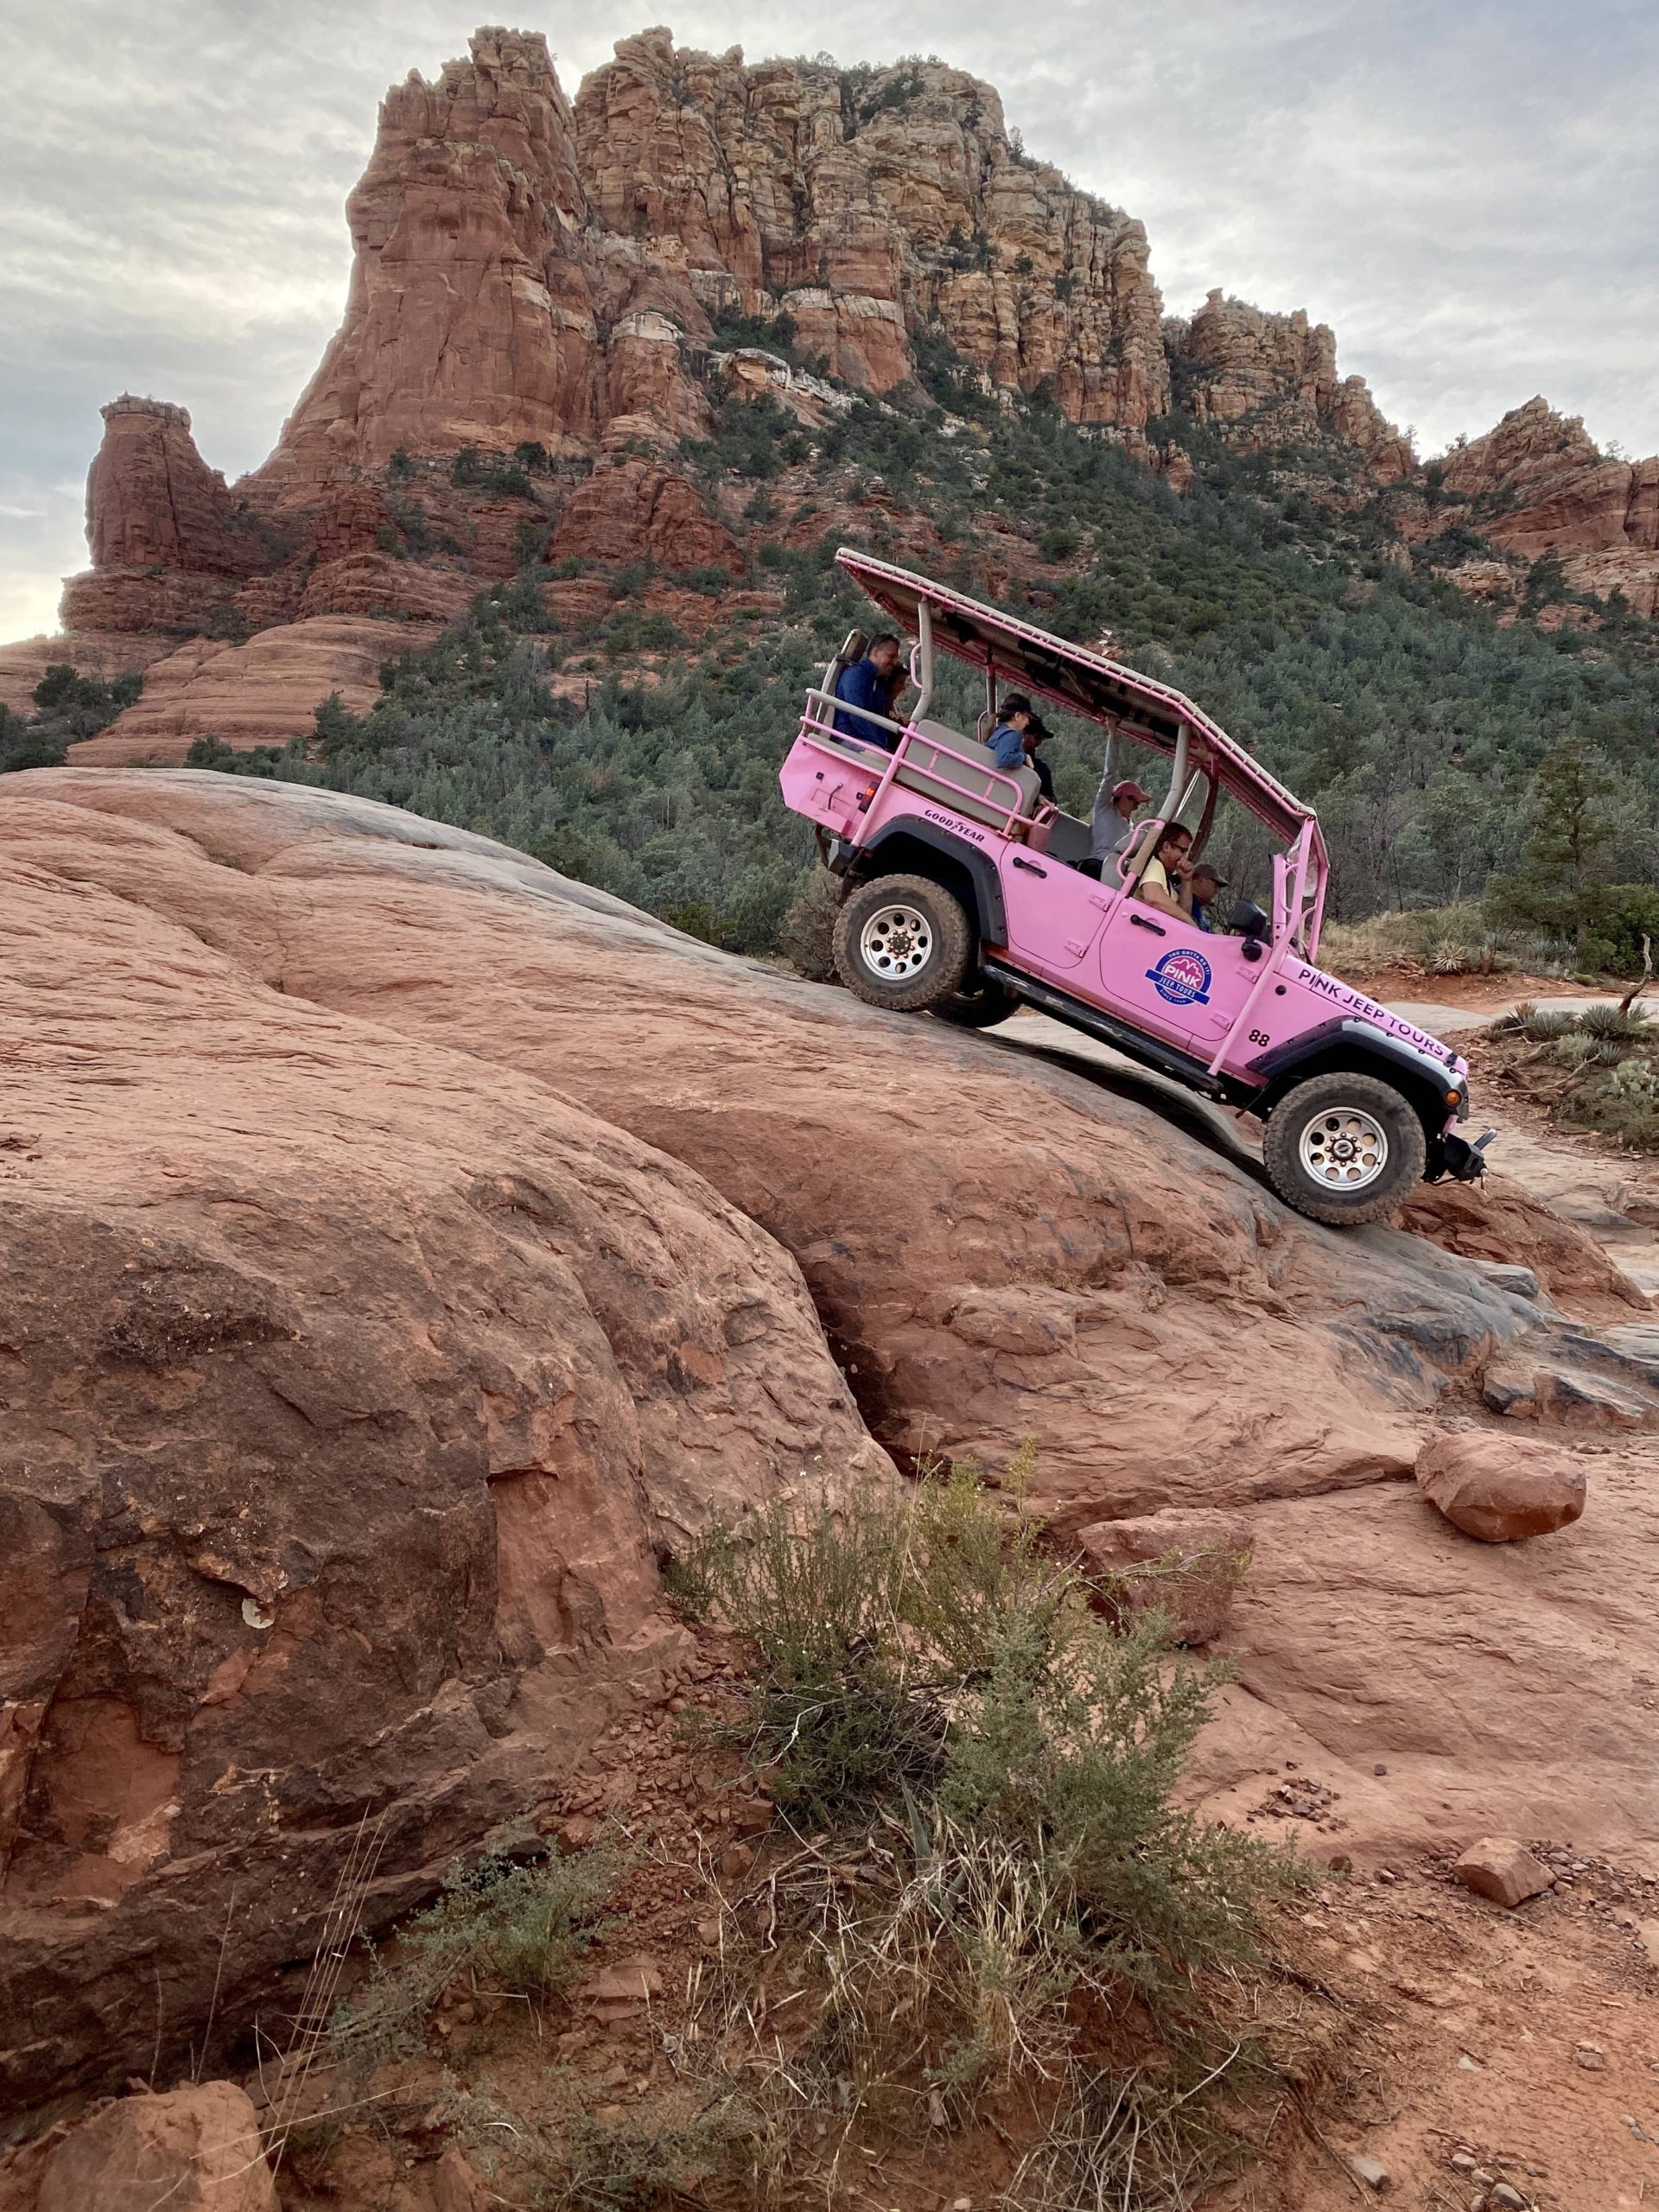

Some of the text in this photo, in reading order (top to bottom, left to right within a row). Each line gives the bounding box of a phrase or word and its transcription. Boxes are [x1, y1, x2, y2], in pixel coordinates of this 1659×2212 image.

[925, 809, 985, 842] GOODYEAR
[1181, 950, 1199, 959] GOTTA
[1159, 976, 1196, 998] JEEP TOURS
[1164, 964, 1201, 988] PINK
[1298, 968, 1445, 1057] PINK JEEP TOURS
[1248, 1028, 1270, 1047] 88
